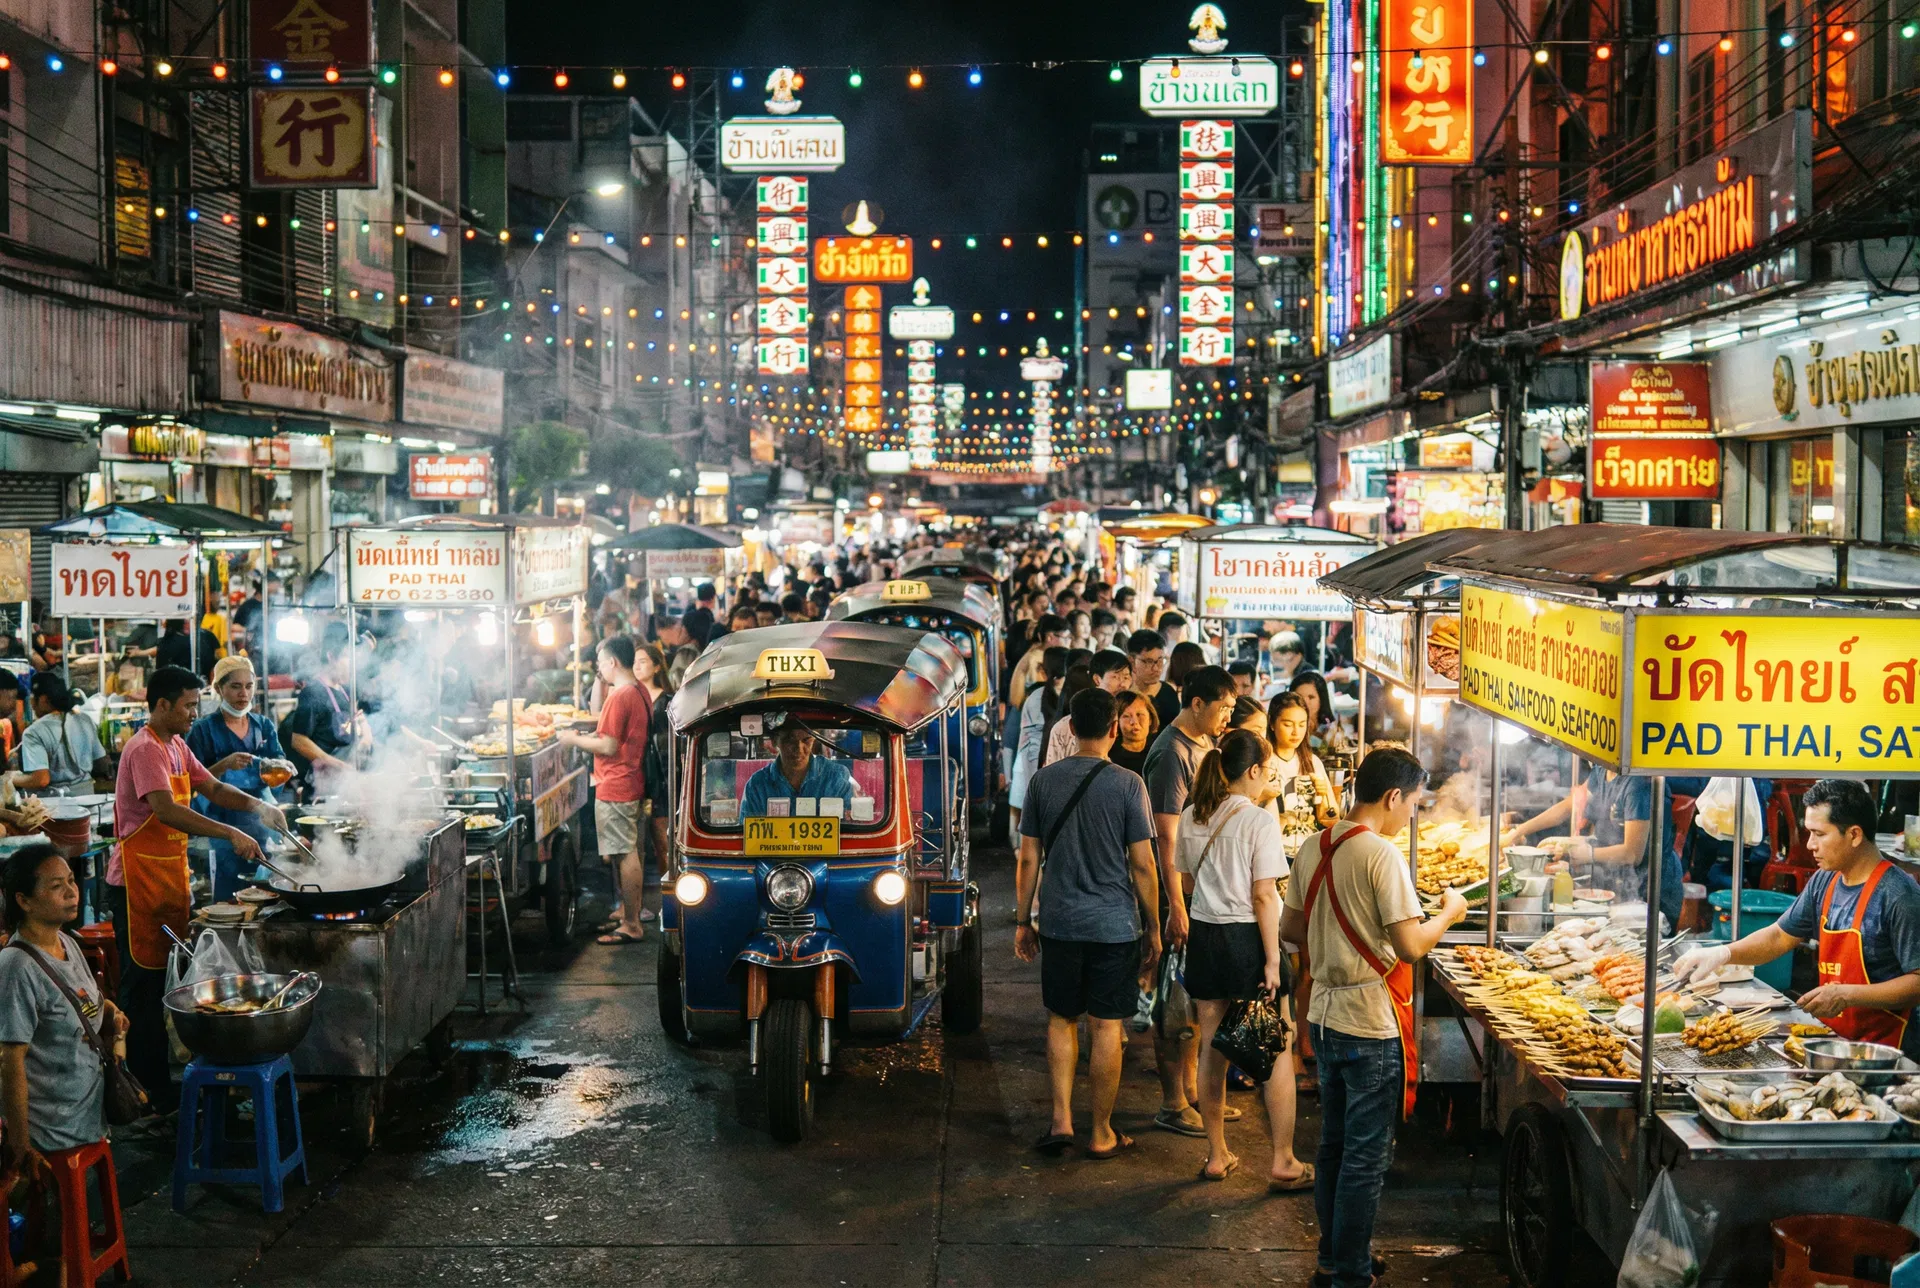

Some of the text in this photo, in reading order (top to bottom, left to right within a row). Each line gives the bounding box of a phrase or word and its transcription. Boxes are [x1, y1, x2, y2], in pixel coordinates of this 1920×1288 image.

[389, 573, 466, 585] PAD THAI
[1463, 665, 1480, 696] PAD
[1482, 671, 1506, 711] THAI,
[1561, 701, 1617, 752] SEAFOOD
[1642, 722, 1723, 756] PAD
[1737, 724, 1842, 763] THAI,
